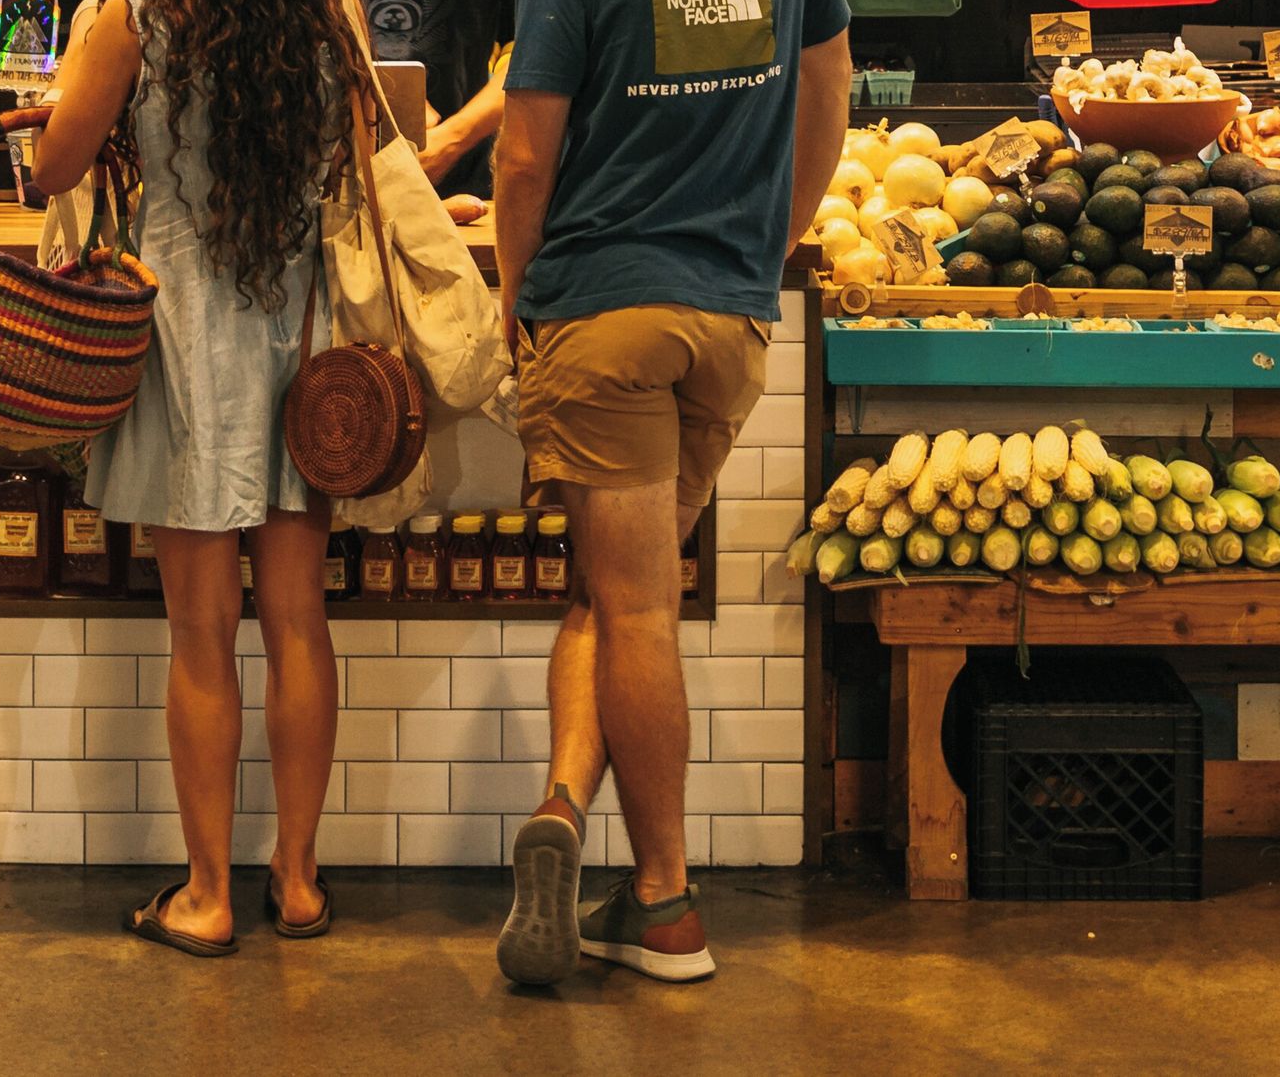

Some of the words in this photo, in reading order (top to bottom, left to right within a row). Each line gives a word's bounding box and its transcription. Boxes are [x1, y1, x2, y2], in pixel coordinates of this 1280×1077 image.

[685, 5, 729, 26] FACE
[627, 83, 679, 97] NEVER
[684, 80, 718, 94] STOP
[722, 66, 782, 91] EXPLONG
